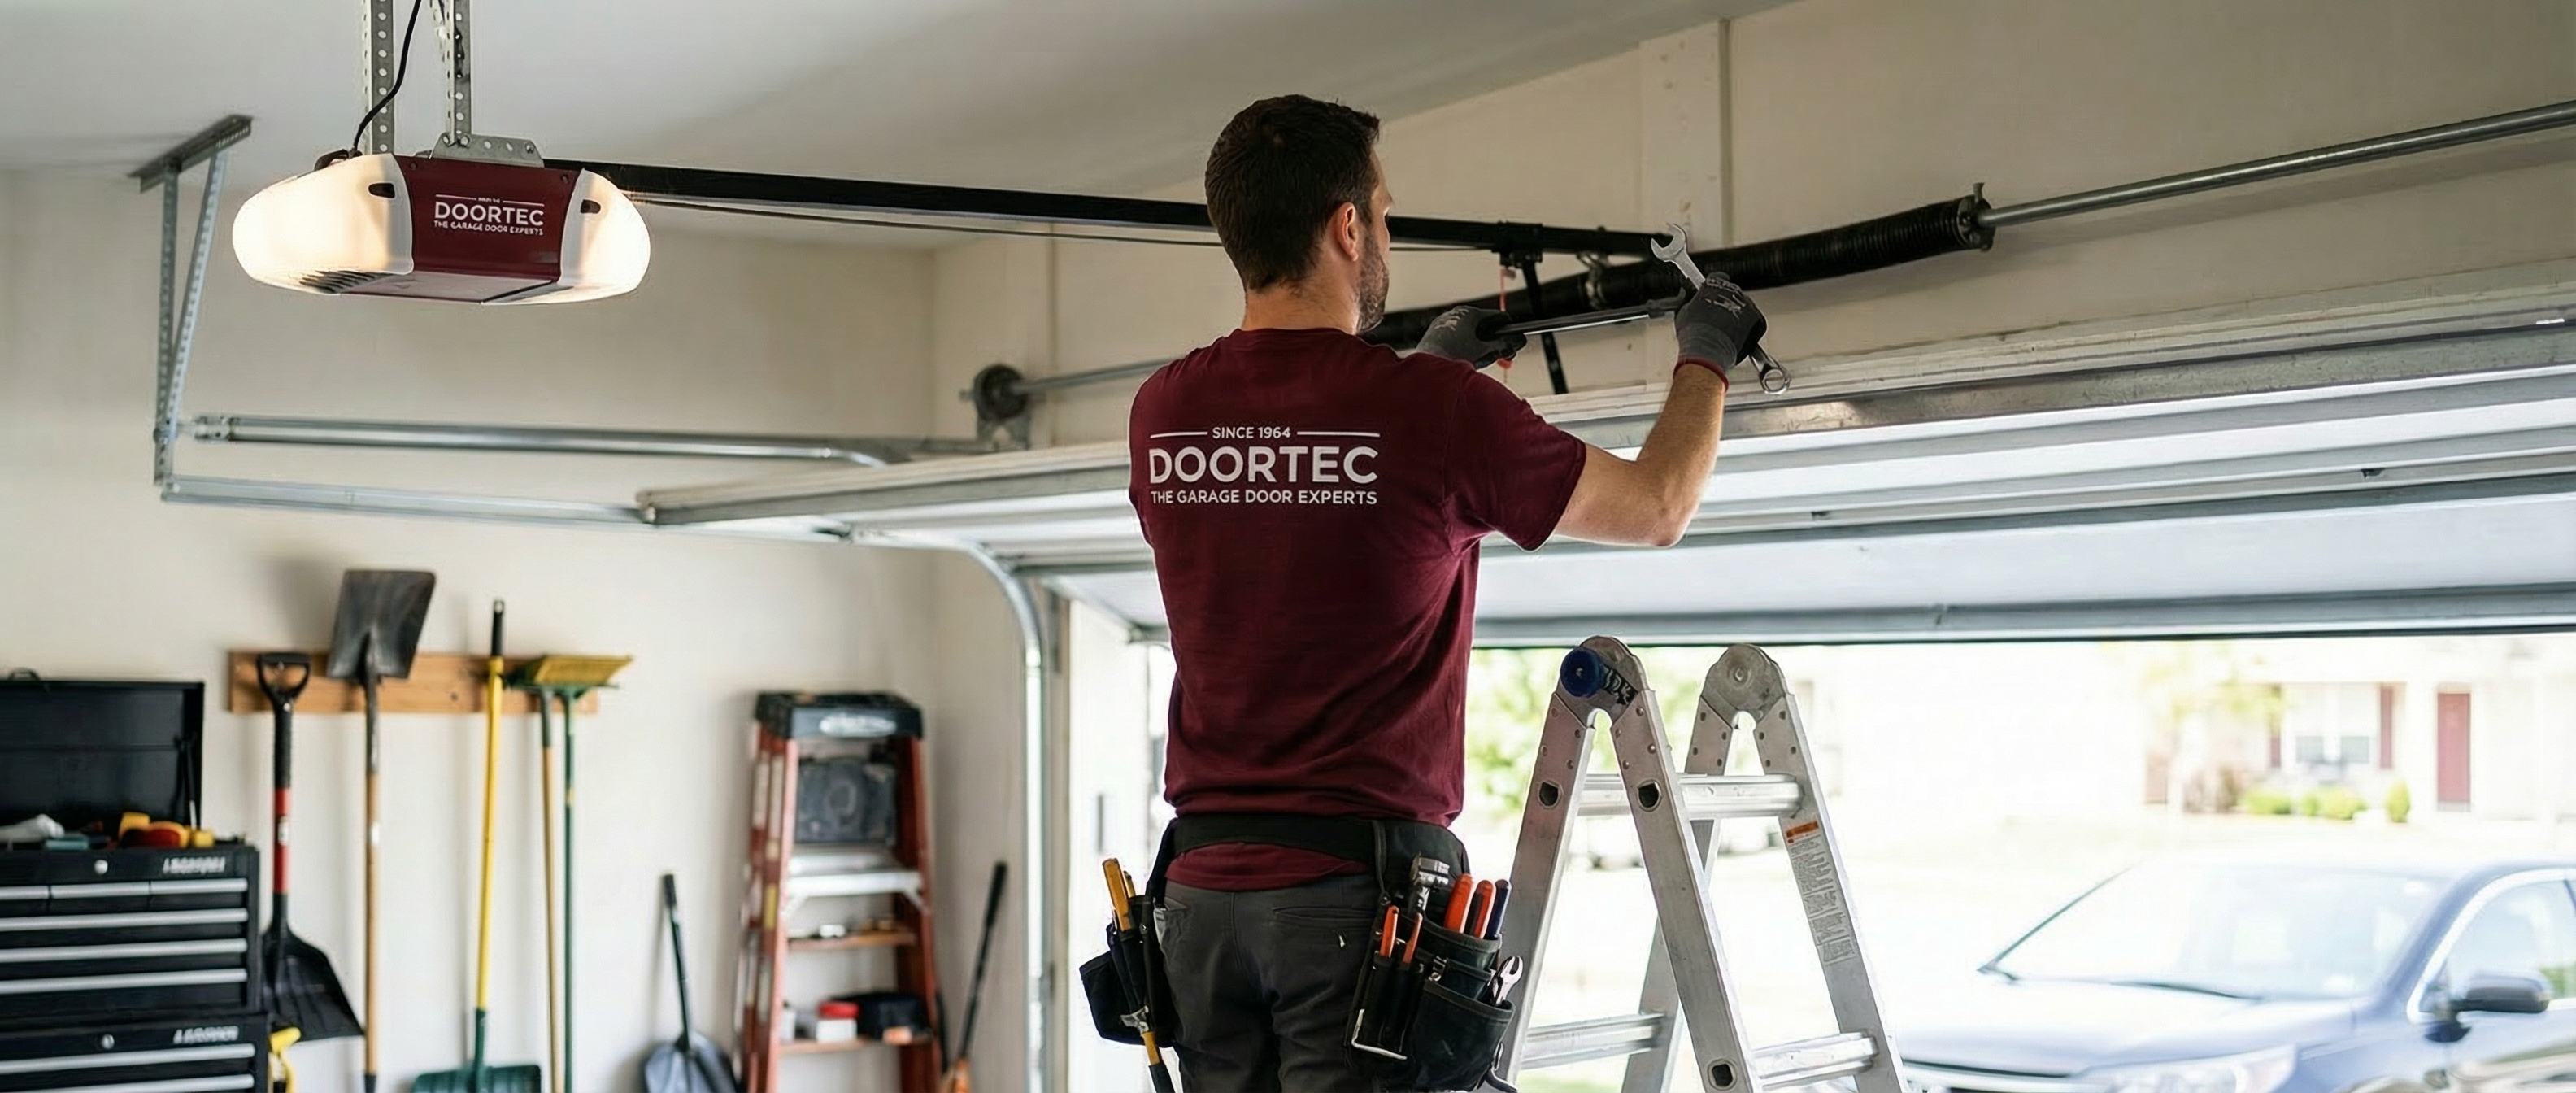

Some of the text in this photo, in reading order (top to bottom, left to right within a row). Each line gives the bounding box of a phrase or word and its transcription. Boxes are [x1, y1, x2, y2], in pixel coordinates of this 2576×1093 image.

[434, 201, 544, 226] DOORTEC
[1212, 426, 1291, 438] SINCE 1964
[1148, 446, 1379, 484] DOORTEC
[1151, 490, 1377, 504] THE GARAGE DOOR EXPERTS
